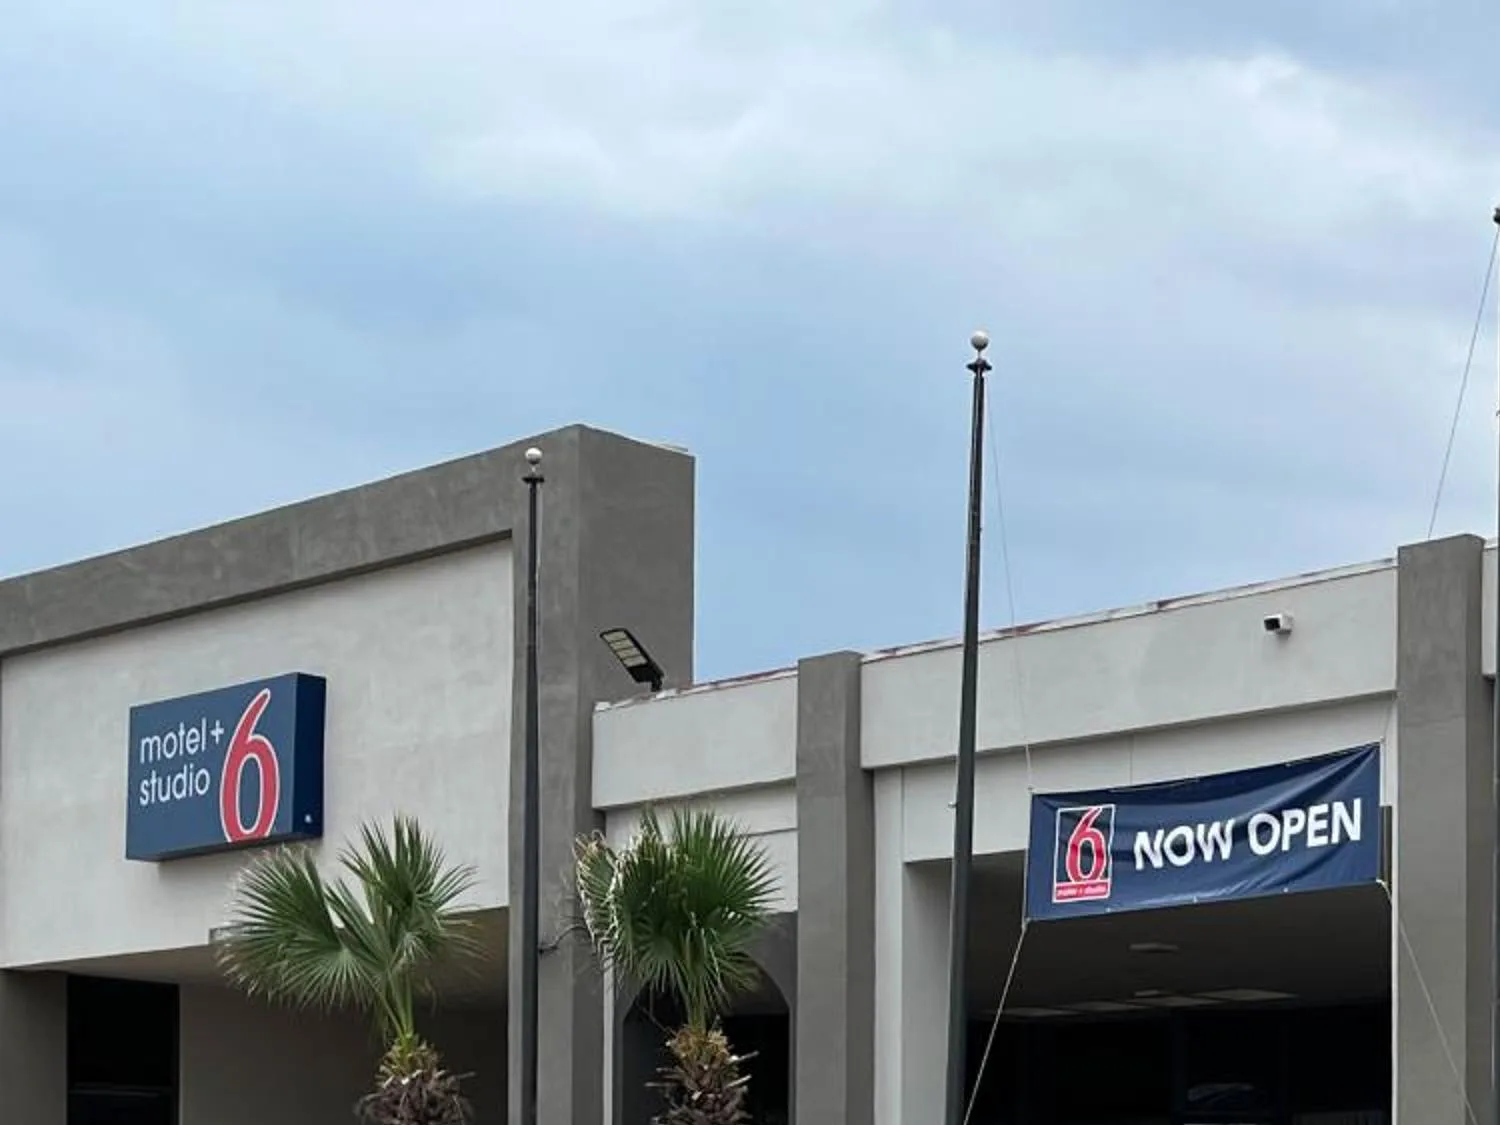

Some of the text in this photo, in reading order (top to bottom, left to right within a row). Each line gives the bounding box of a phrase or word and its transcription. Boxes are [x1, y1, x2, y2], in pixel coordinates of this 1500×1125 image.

[139, 763, 211, 807] studio
[219, 688, 280, 843] 6
[1066, 806, 1107, 884] 6
[1133, 798, 1363, 871] NOW OPEN
